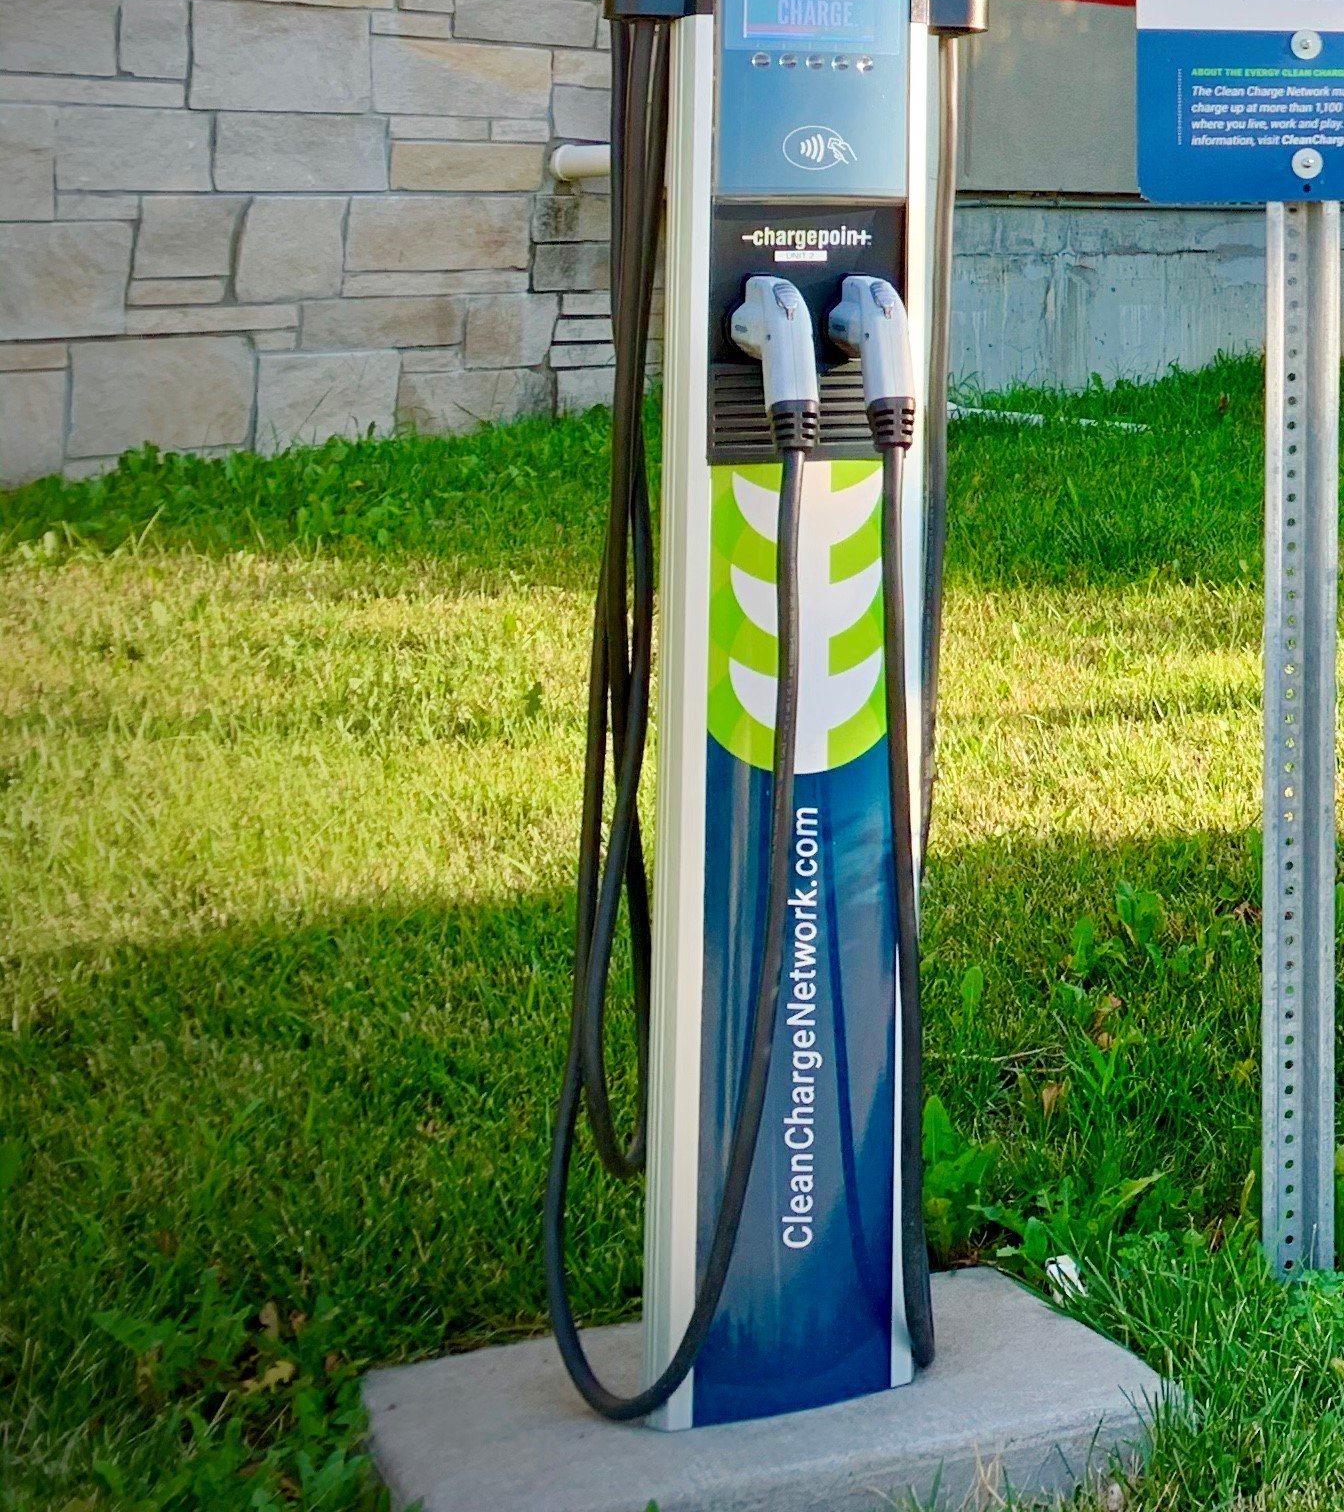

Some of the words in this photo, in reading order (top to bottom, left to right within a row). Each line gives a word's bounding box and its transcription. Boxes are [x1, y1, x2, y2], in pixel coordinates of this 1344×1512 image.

[1191, 68, 1222, 77] ABOUT
[1225, 68, 1243, 77] THE
[1192, 85, 1212, 96] The
[1214, 86, 1245, 97] Clean
[1246, 86, 1285, 99] Charge
[1286, 86, 1331, 97] Network
[1191, 102, 1229, 115] charge
[1230, 103, 1244, 115] up
[1245, 103, 1258, 113] at
[1259, 104, 1287, 113] more
[1289, 102, 1313, 113] than
[1191, 118, 1225, 129] where
[1226, 120, 1246, 131] you
[1270, 119, 1296, 129] work
[1298, 118, 1319, 128] and
[1191, 134, 1256, 147] information,
[1257, 135, 1280, 145] visit
[781, 806, 823, 1250] CleanChargeNetwork.com
